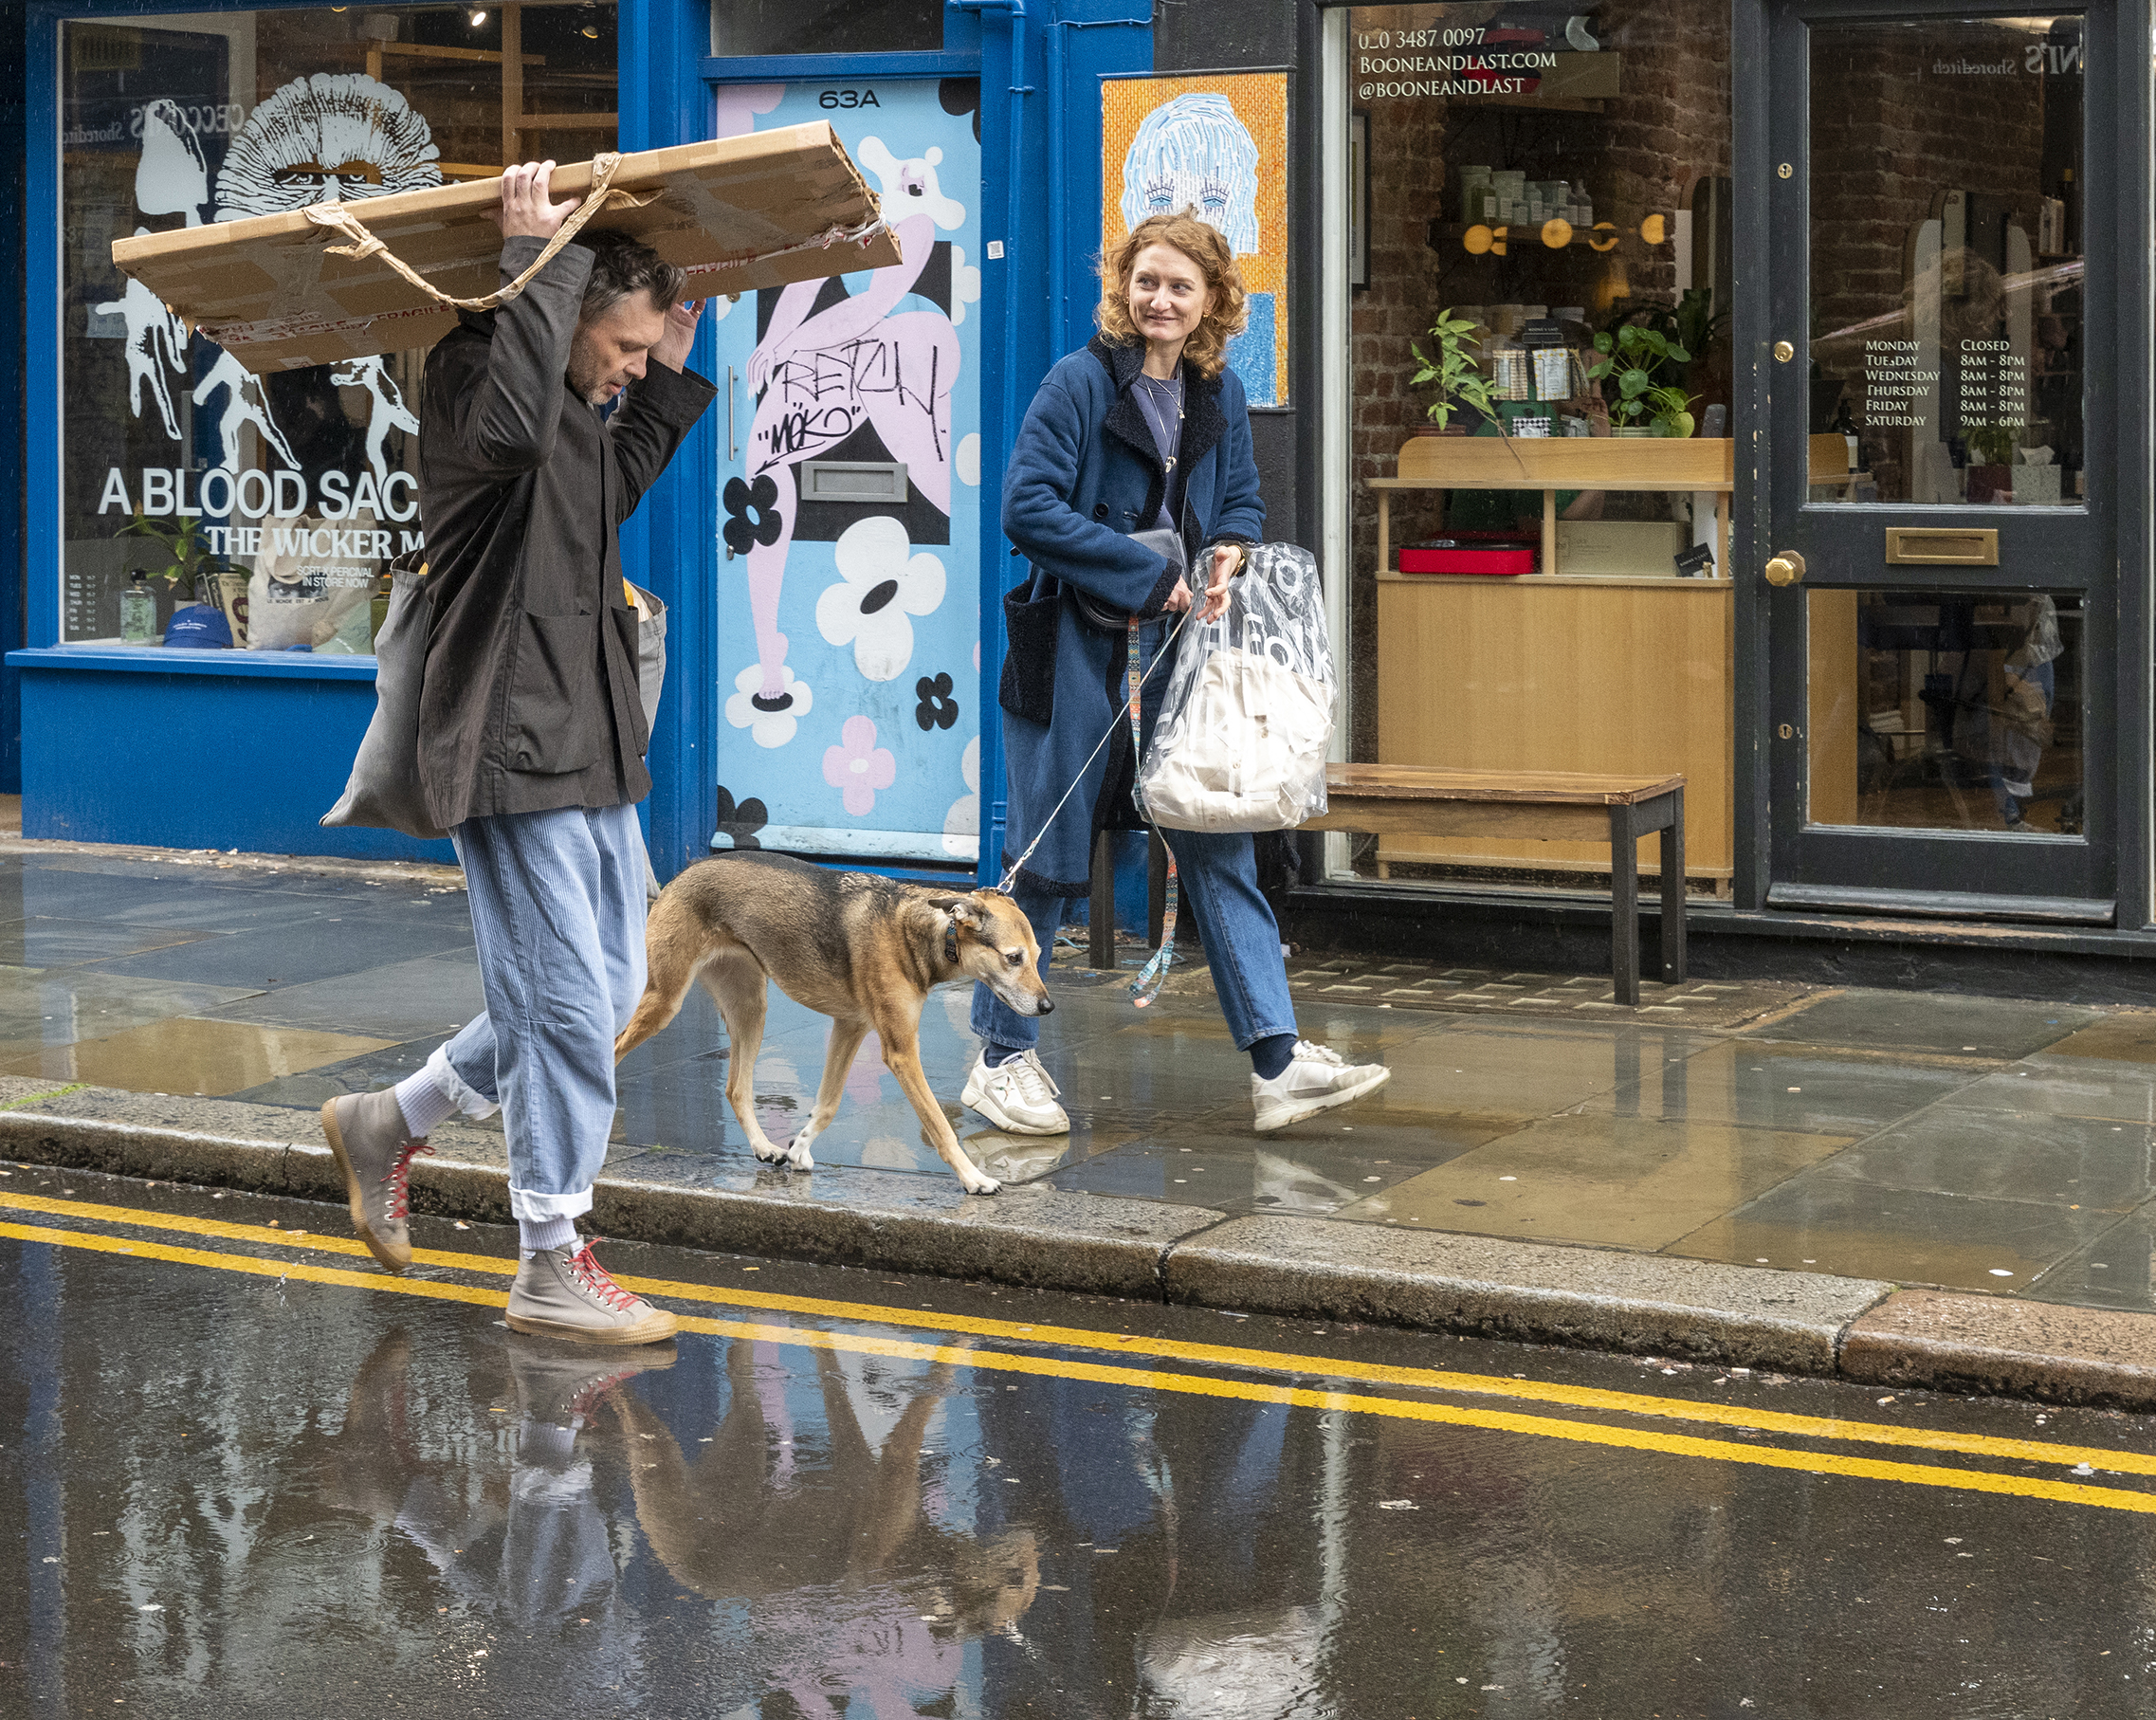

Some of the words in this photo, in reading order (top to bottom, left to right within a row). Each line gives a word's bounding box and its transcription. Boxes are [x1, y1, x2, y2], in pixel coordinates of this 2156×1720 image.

[1359, 32, 1390, 50] 00
[1396, 29, 1437, 48] 3487
[1443, 27, 1486, 46] 0097
[1360, 52, 1557, 74] BOONEANDLAST.COM
[1359, 78, 1525, 100] @BOONEANDLAST
[818, 89, 881, 109] 63A
[1865, 340, 1921, 352] MONDAY
[1960, 339, 2010, 352] CLOSED
[1960, 355, 1987, 367] 8AM
[1999, 355, 2025, 367] 8PM
[1865, 370, 1941, 381] WEDNESDAY
[1960, 370, 1987, 382] 8AM
[1999, 370, 2025, 382] 8PM
[1868, 385, 1930, 396] THURSDAY
[1960, 385, 1987, 397] 8AM
[1999, 385, 2025, 397] 8PM
[1866, 400, 1909, 412] FRIDAY
[1960, 400, 1987, 412] 8AM
[1999, 400, 2025, 412] 8PM
[1865, 414, 1927, 427] SATURDAY
[1960, 414, 1987, 427] 9AM
[1999, 414, 2025, 427] 6PM
[98, 467, 133, 515] A
[142, 468, 307, 520] BLOOD
[318, 470, 422, 522] SAC
[204, 526, 265, 557] THE
[272, 528, 394, 560] WICKER
[330, 566, 375, 578] PERCIVAL
[302, 576, 313, 587] IN
[313, 576, 344, 588] STORE
[345, 577, 369, 588] NOW
